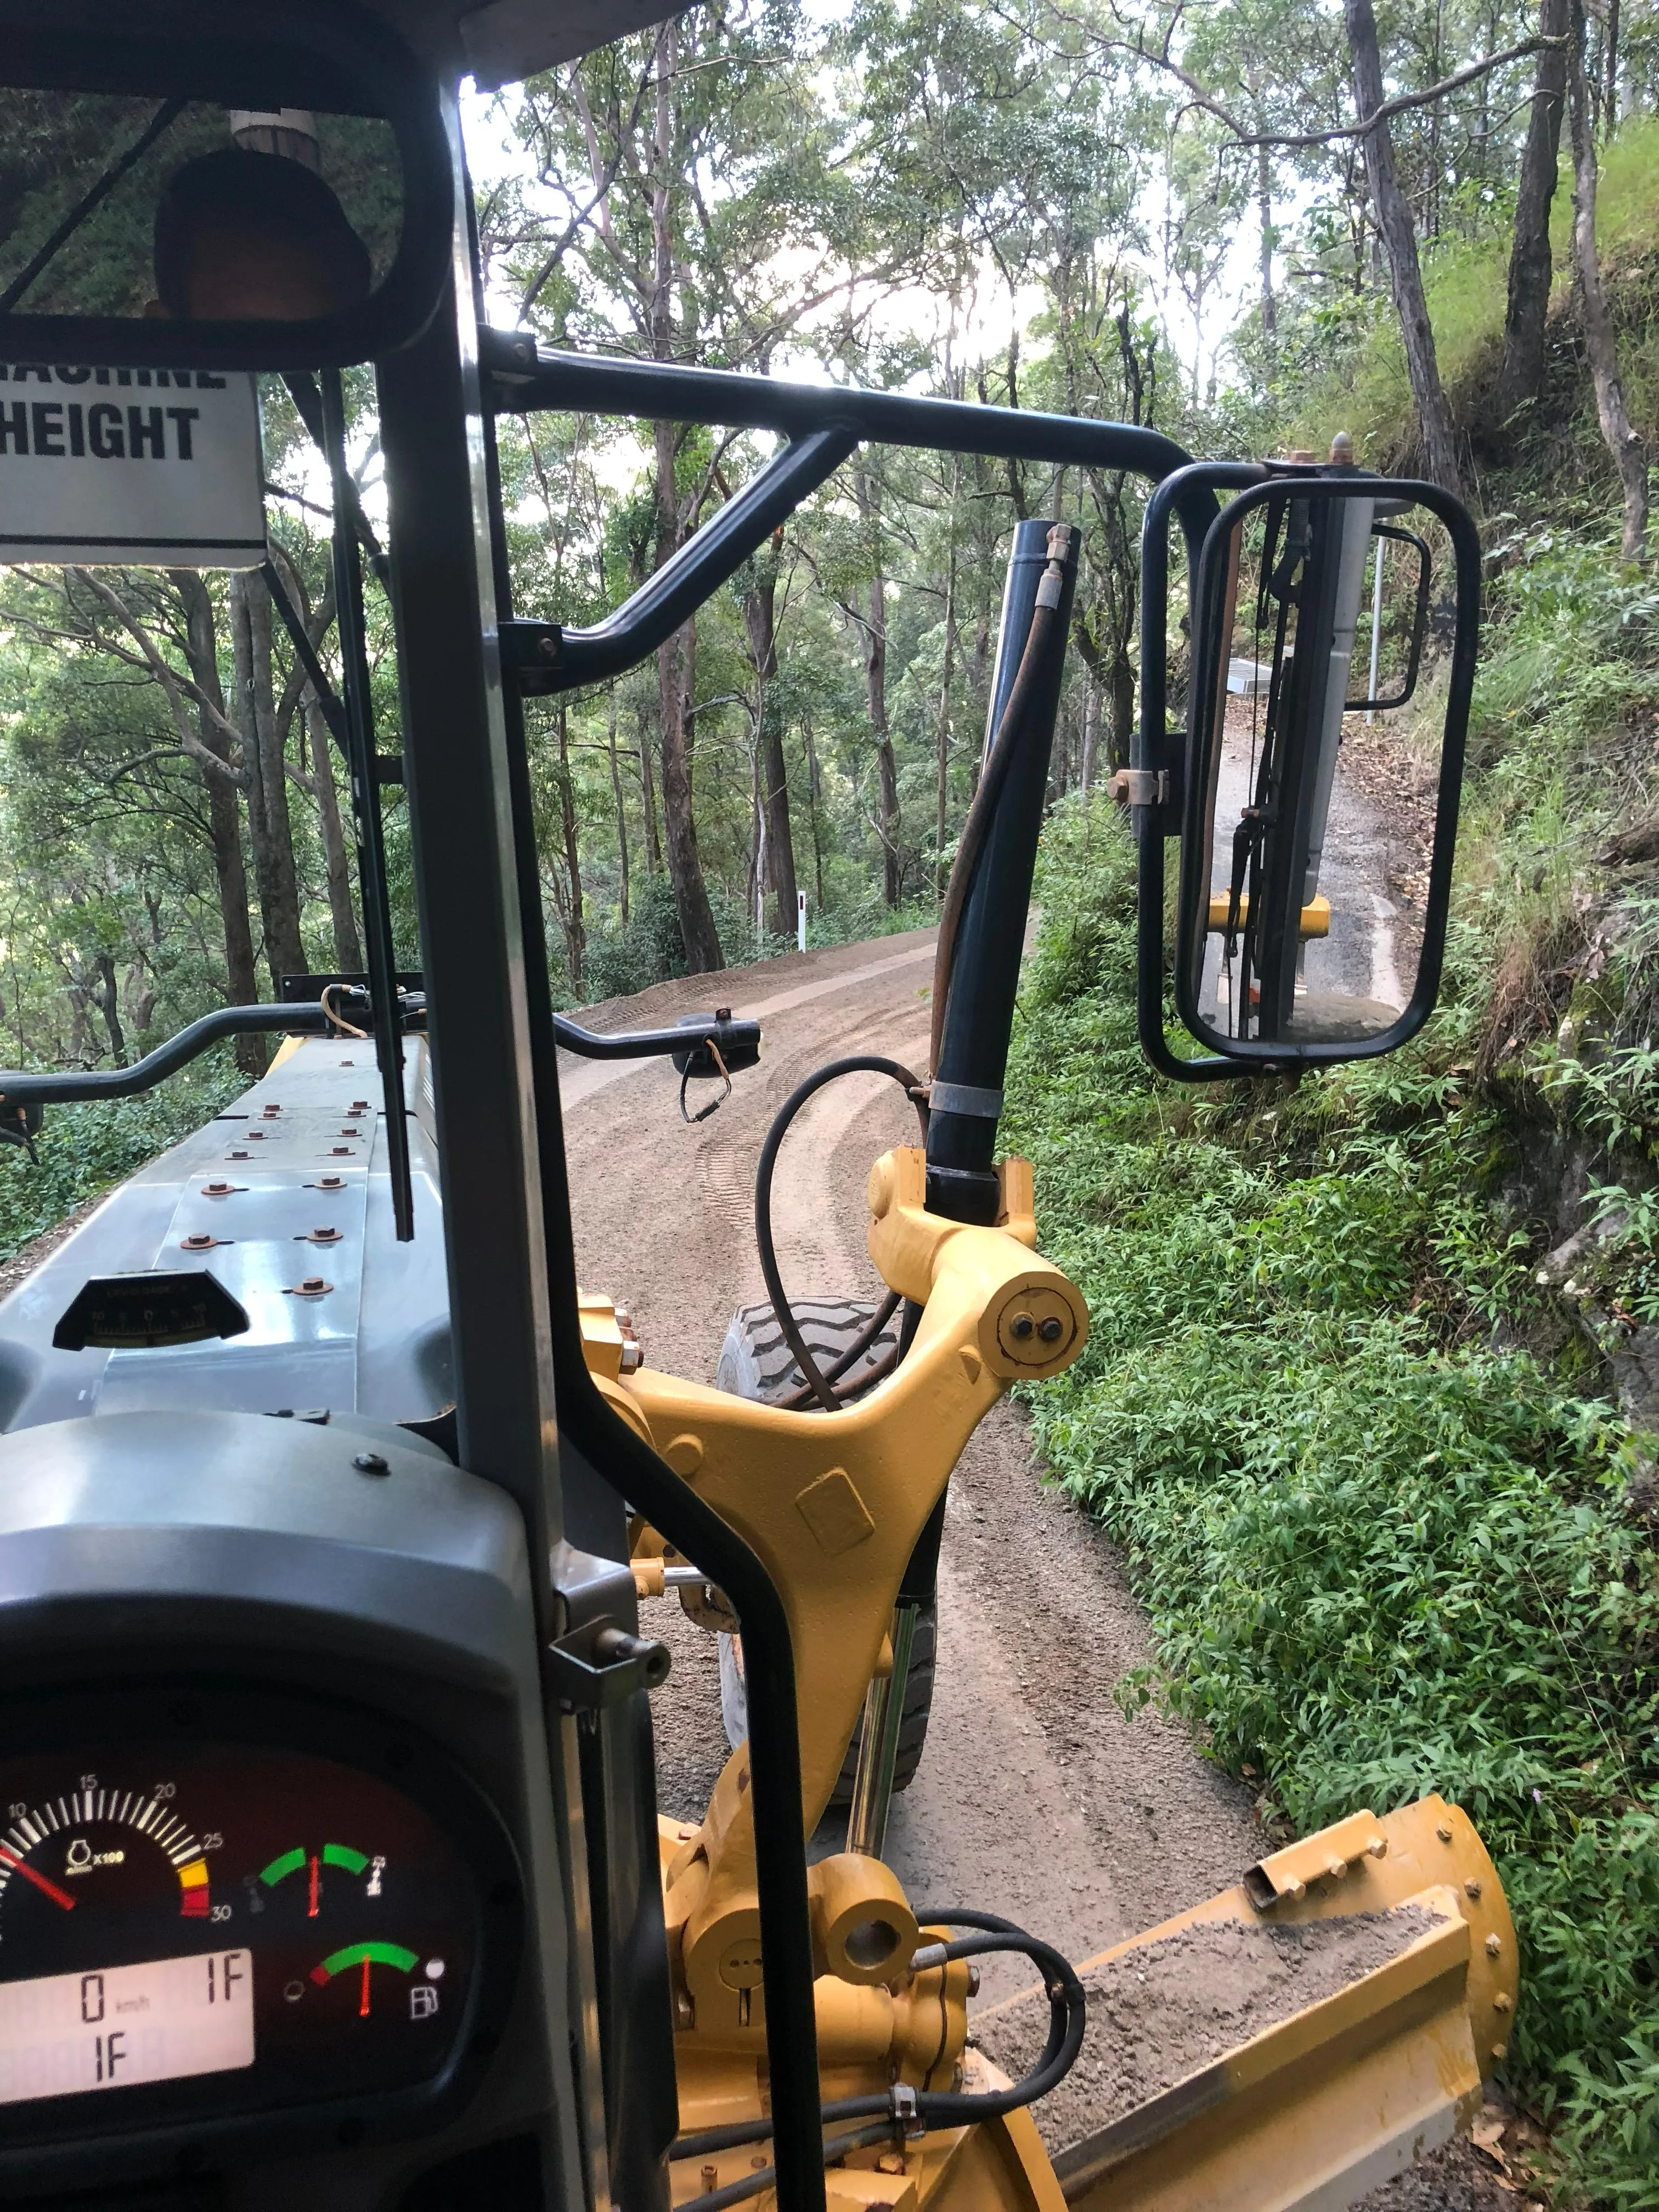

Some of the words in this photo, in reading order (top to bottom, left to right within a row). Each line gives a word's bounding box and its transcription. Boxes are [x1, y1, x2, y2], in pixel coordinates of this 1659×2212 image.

[0, 401, 199, 460] HEIGHT
[80, 1774, 98, 1790] 15
[154, 1782, 176, 1800] 20
[9, 1803, 27, 1819] 10
[203, 1832, 224, 1849] 25
[210, 1905, 232, 1922] 30
[81, 1974, 104, 2023] 0
